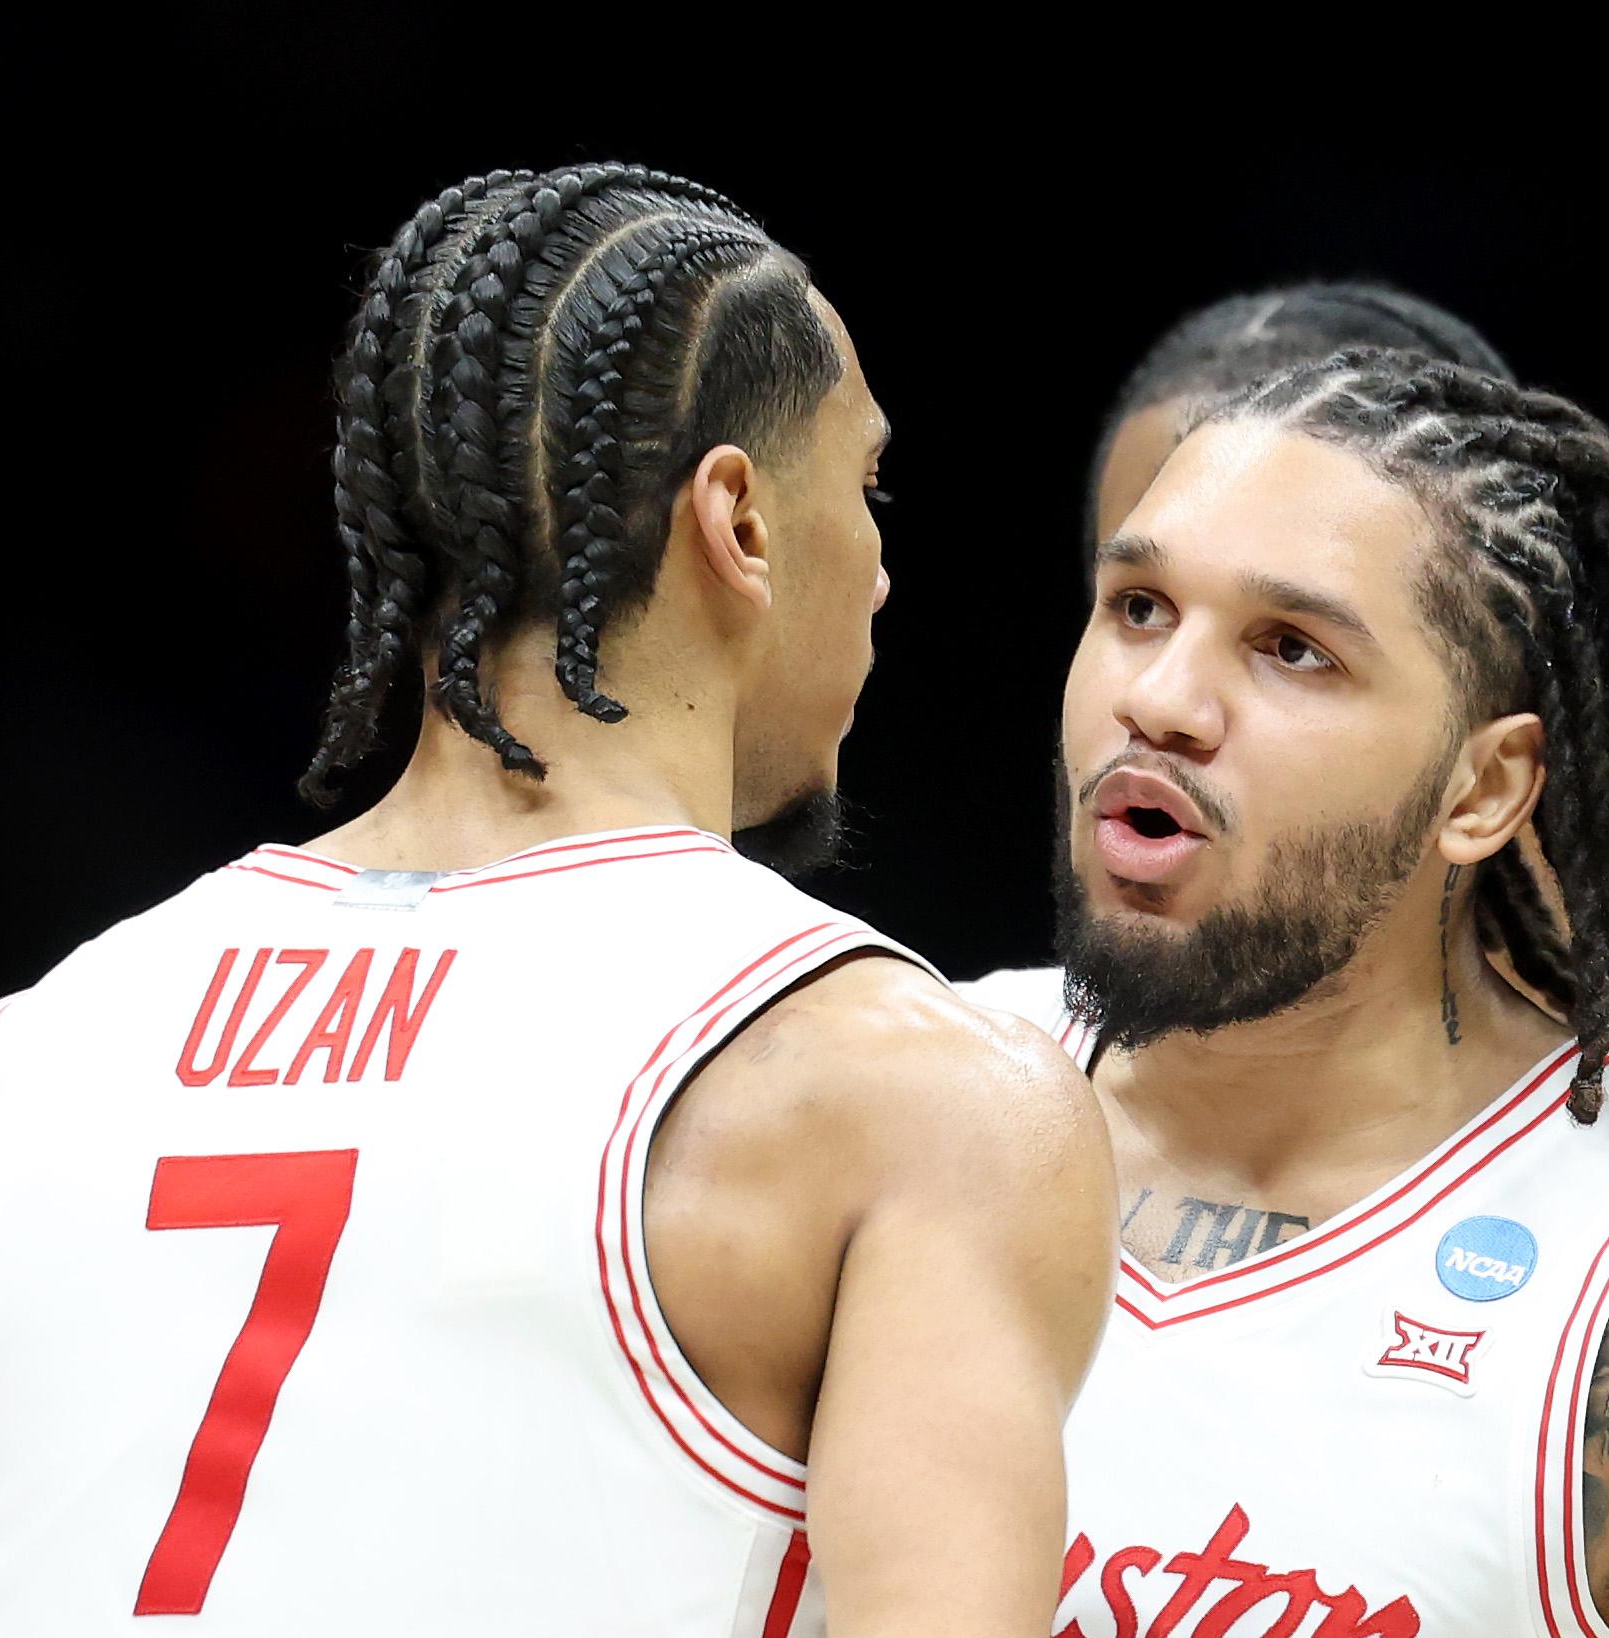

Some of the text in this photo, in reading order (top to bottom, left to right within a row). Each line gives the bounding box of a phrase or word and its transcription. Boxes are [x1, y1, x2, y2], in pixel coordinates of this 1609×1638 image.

[175, 947, 458, 1087] UZAN
[1444, 1246, 1529, 1287] NCAA
[133, 1148, 360, 1617] 7
[1378, 1310, 1486, 1384] XII
